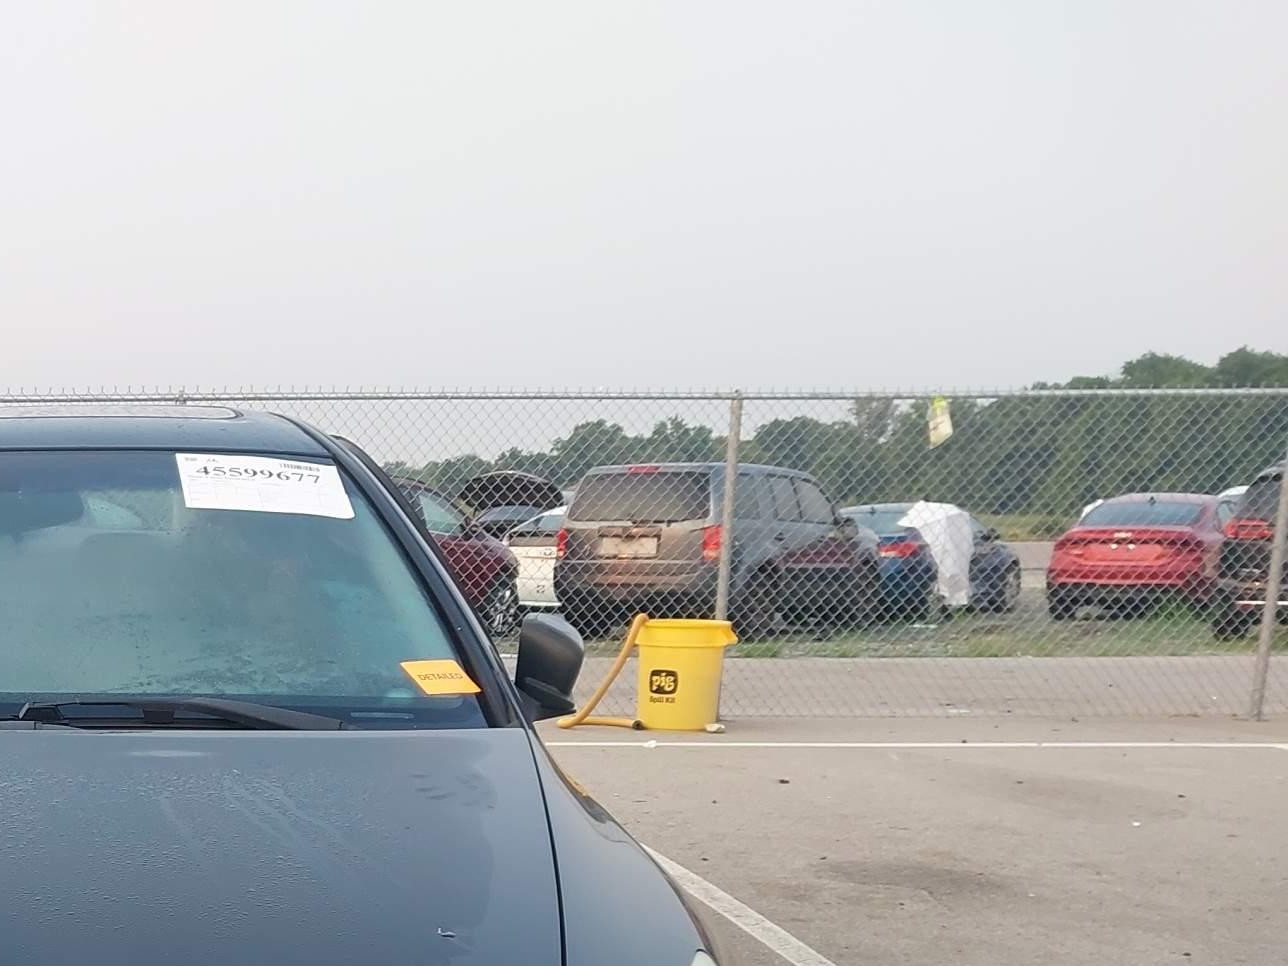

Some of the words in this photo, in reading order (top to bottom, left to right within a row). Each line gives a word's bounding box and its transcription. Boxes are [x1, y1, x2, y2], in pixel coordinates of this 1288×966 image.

[195, 466, 321, 485] 45599677
[417, 672, 463, 681] DETAILED
[652, 672, 675, 691] pig
